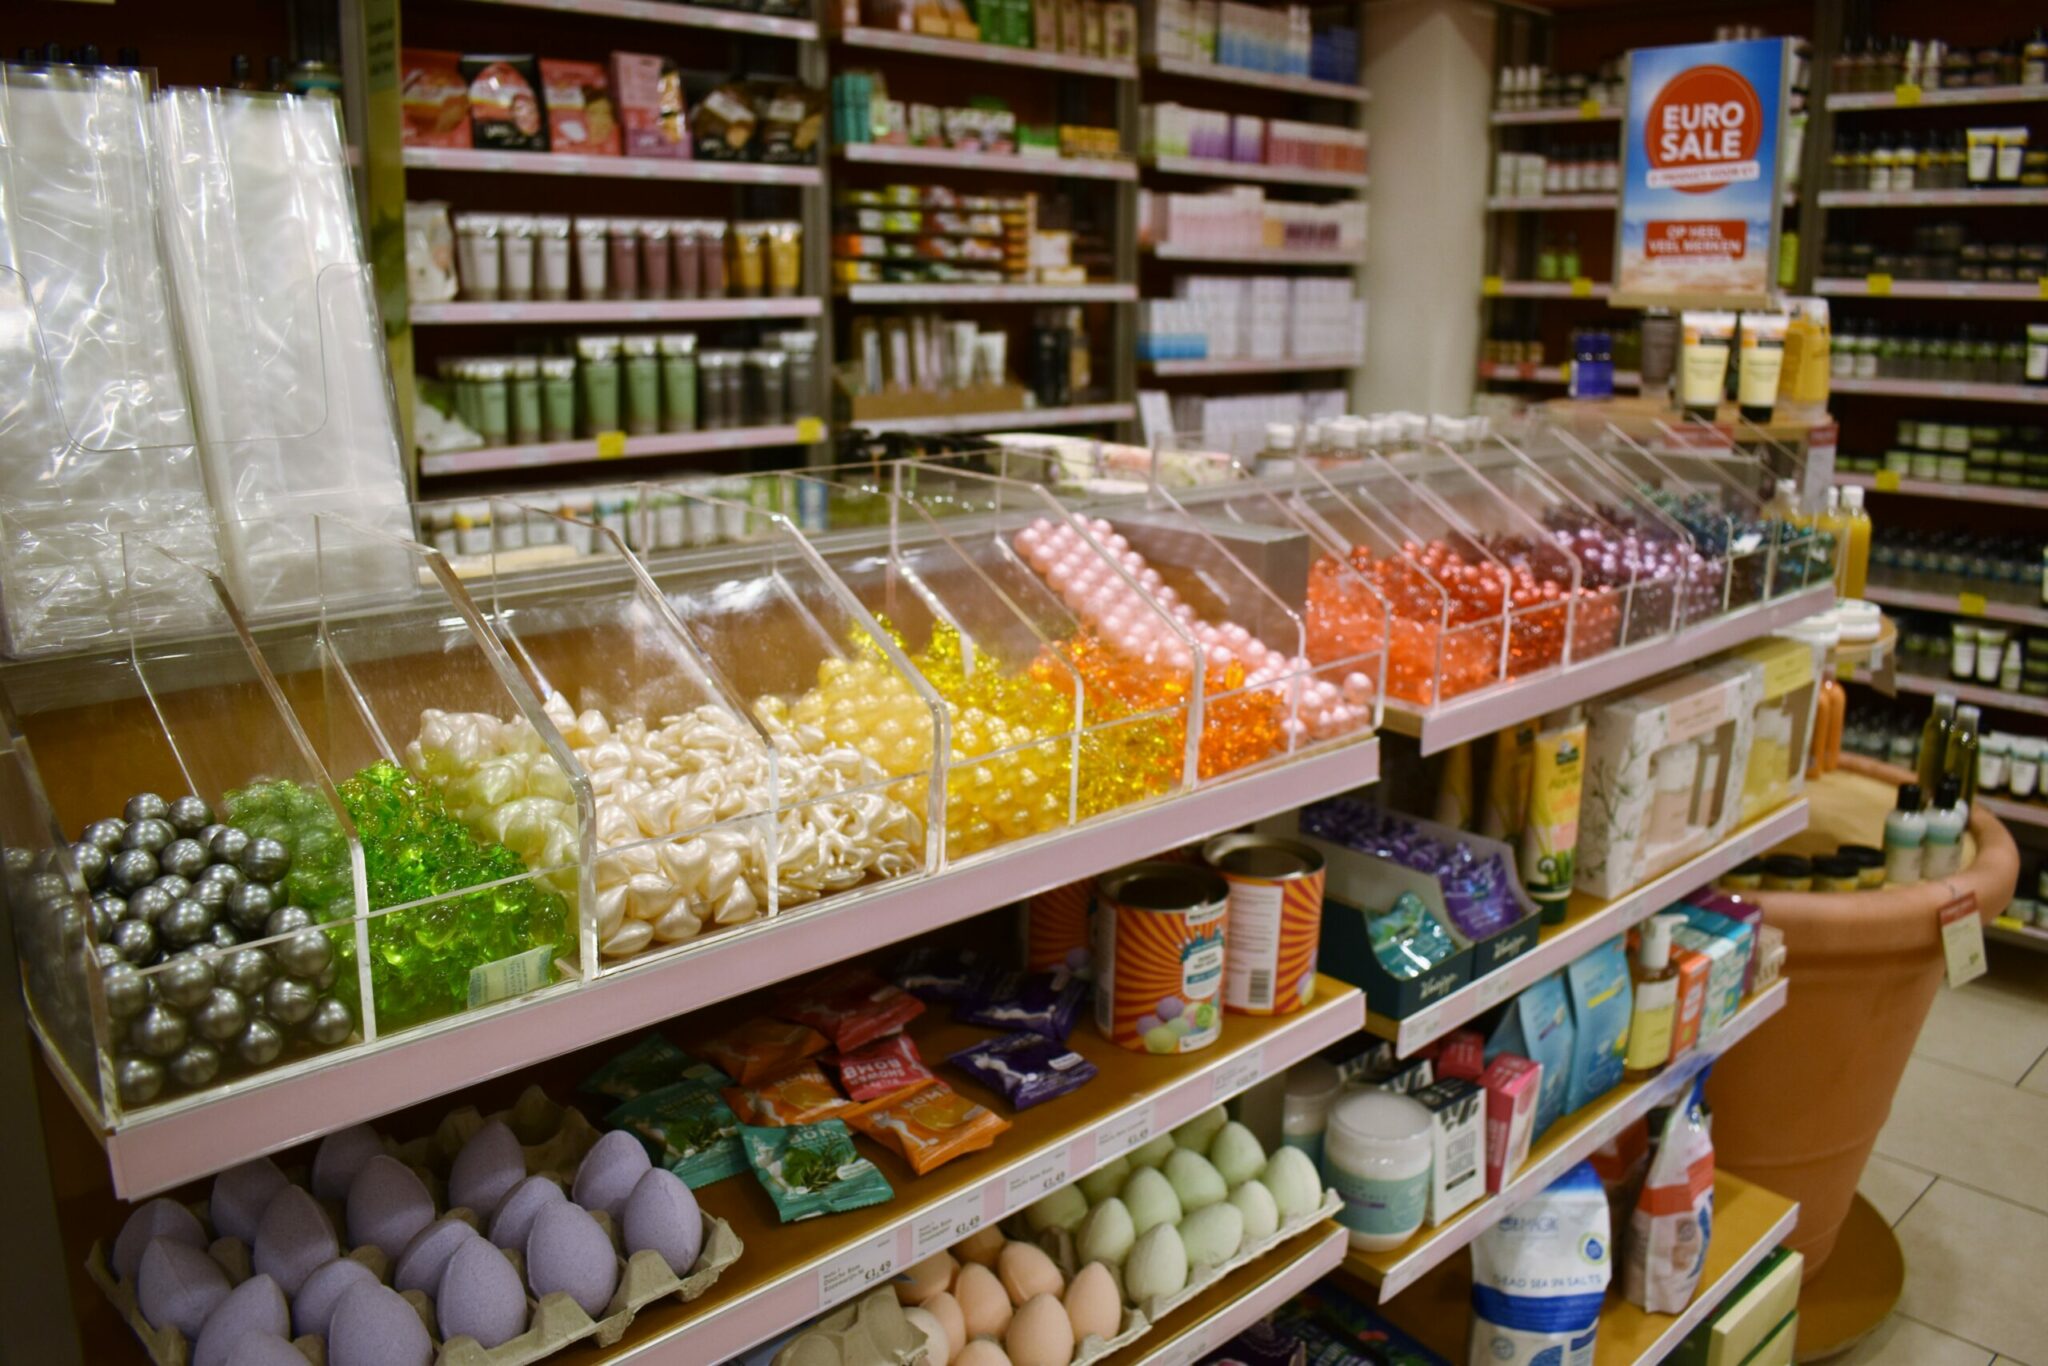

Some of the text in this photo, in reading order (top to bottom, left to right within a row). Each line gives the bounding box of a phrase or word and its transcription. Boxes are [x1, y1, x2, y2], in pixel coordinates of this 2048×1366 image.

[1663, 100, 1745, 131] EURO
[1660, 130, 1742, 162] SALE
[1666, 224, 1723, 240] OP HEEL
[1649, 238, 1742, 254] VEEL MERKEN
[956, 1215, 981, 1234] €1,49
[864, 1260, 892, 1281] €1,49
[1567, 1274, 1602, 1287] SALTS
